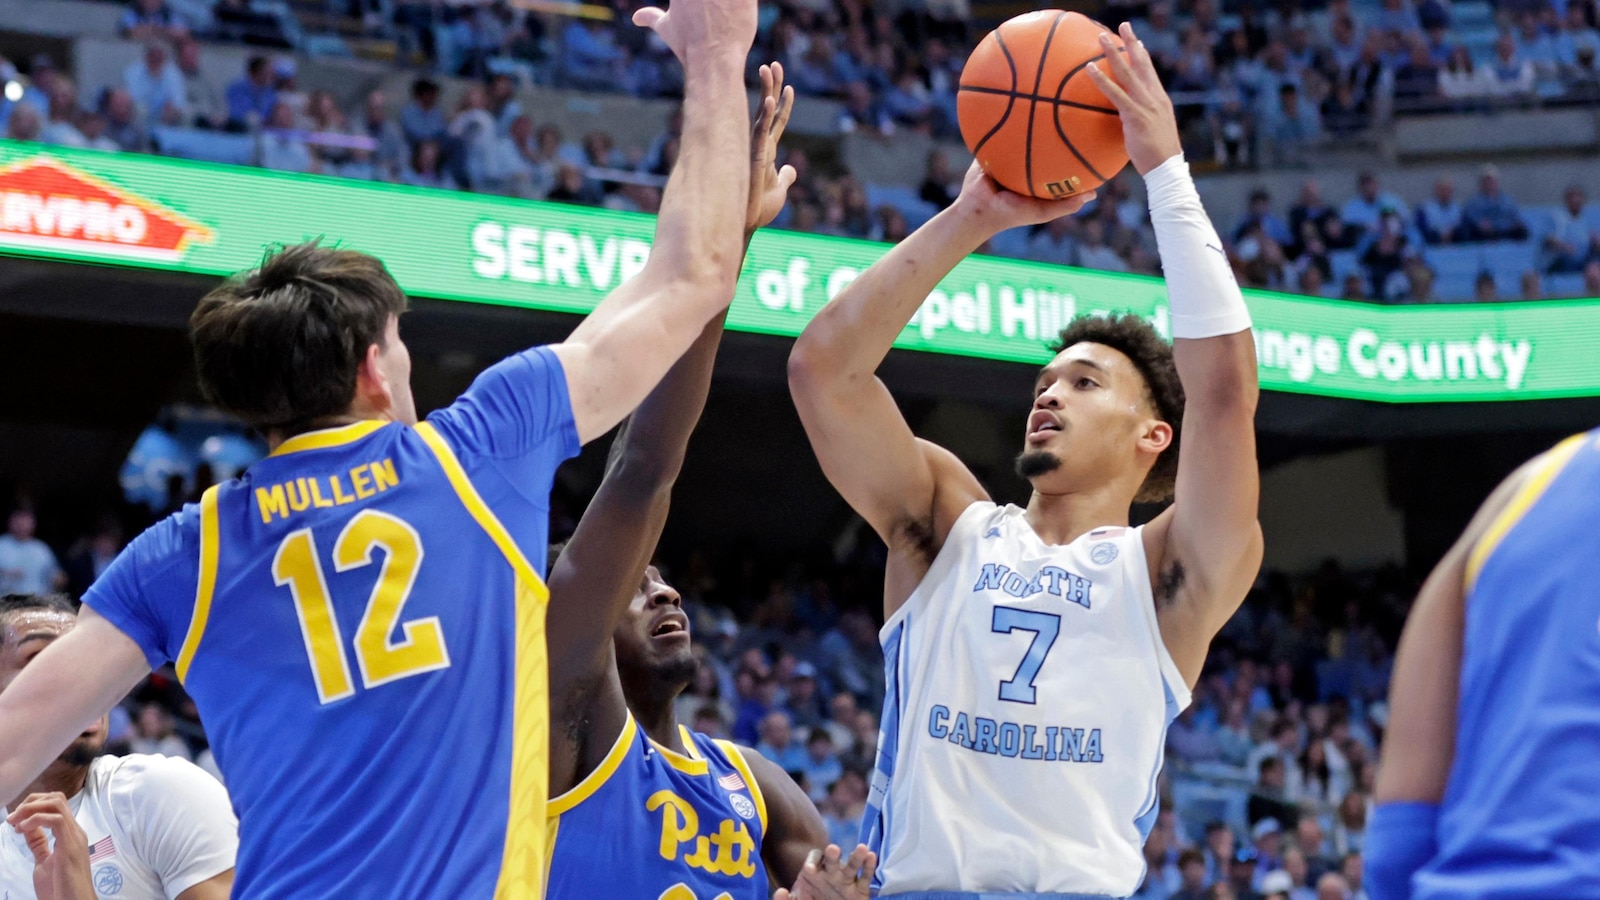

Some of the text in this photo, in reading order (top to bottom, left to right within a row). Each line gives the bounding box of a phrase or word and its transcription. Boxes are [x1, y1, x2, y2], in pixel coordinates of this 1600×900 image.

[0, 190, 147, 242] RVPRO
[472, 222, 651, 291] SERVP
[756, 257, 809, 312] of
[1000, 284, 1076, 342] Hill
[1347, 328, 1532, 390] County
[254, 458, 400, 524] MULLEN
[271, 508, 451, 705] 12
[973, 563, 1092, 609] NORTH
[991, 605, 1062, 705] 7
[928, 704, 1104, 763] CAROLINA
[646, 789, 757, 879] Pitt
